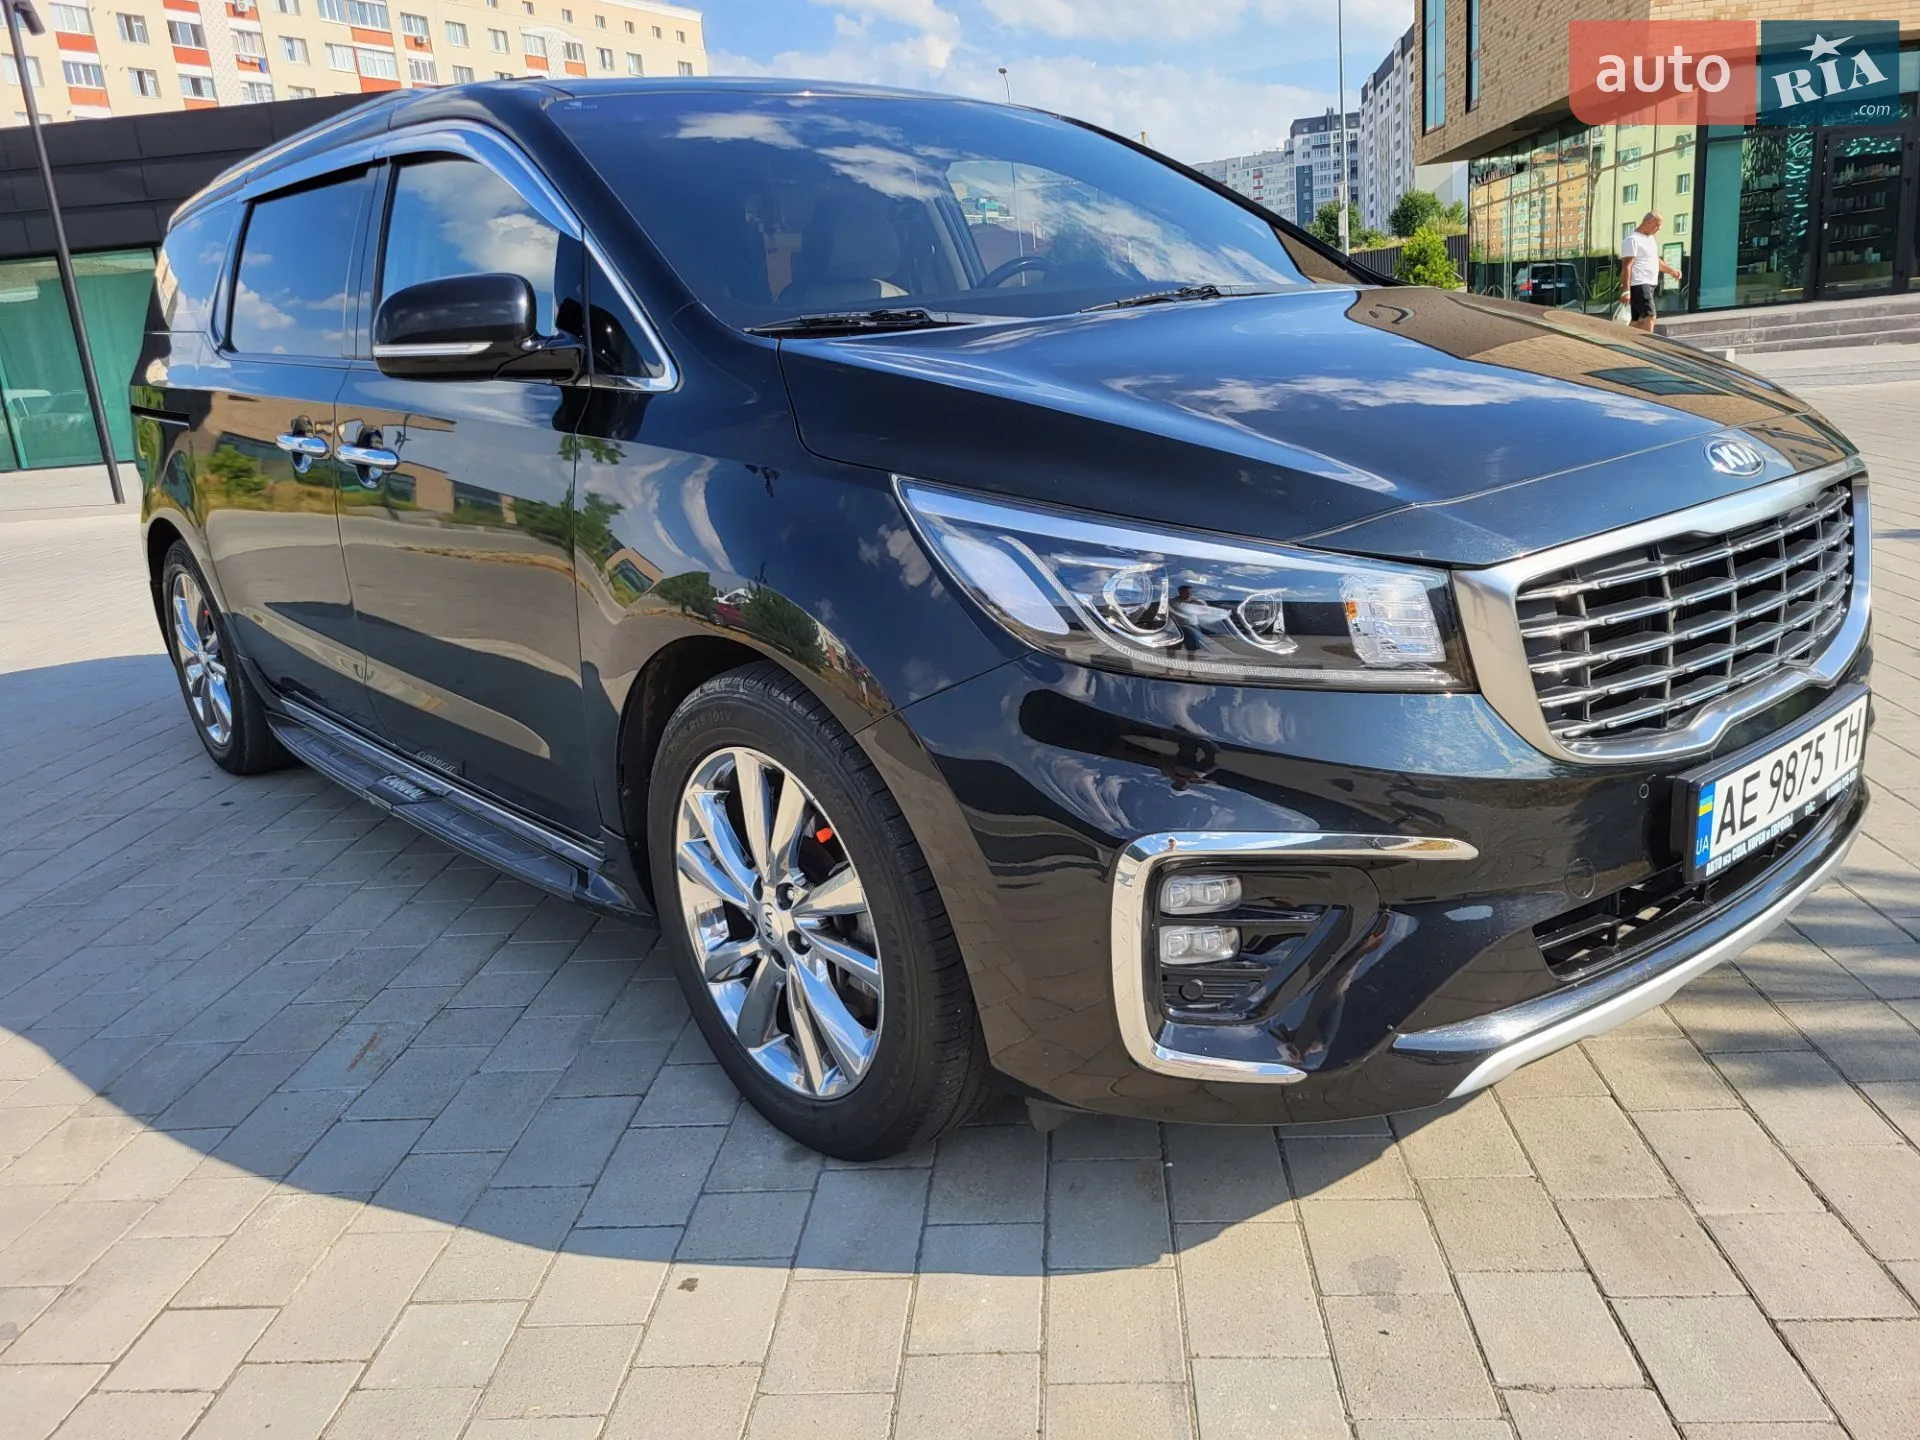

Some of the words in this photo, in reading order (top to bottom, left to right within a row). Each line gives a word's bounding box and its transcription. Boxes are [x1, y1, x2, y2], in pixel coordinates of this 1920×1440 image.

[1715, 771, 1761, 845] AE
[1768, 733, 1825, 815] 9875
[1834, 708, 1862, 771] TH
[1696, 834, 1709, 856] UA
[764, 912, 773, 940] KIA
